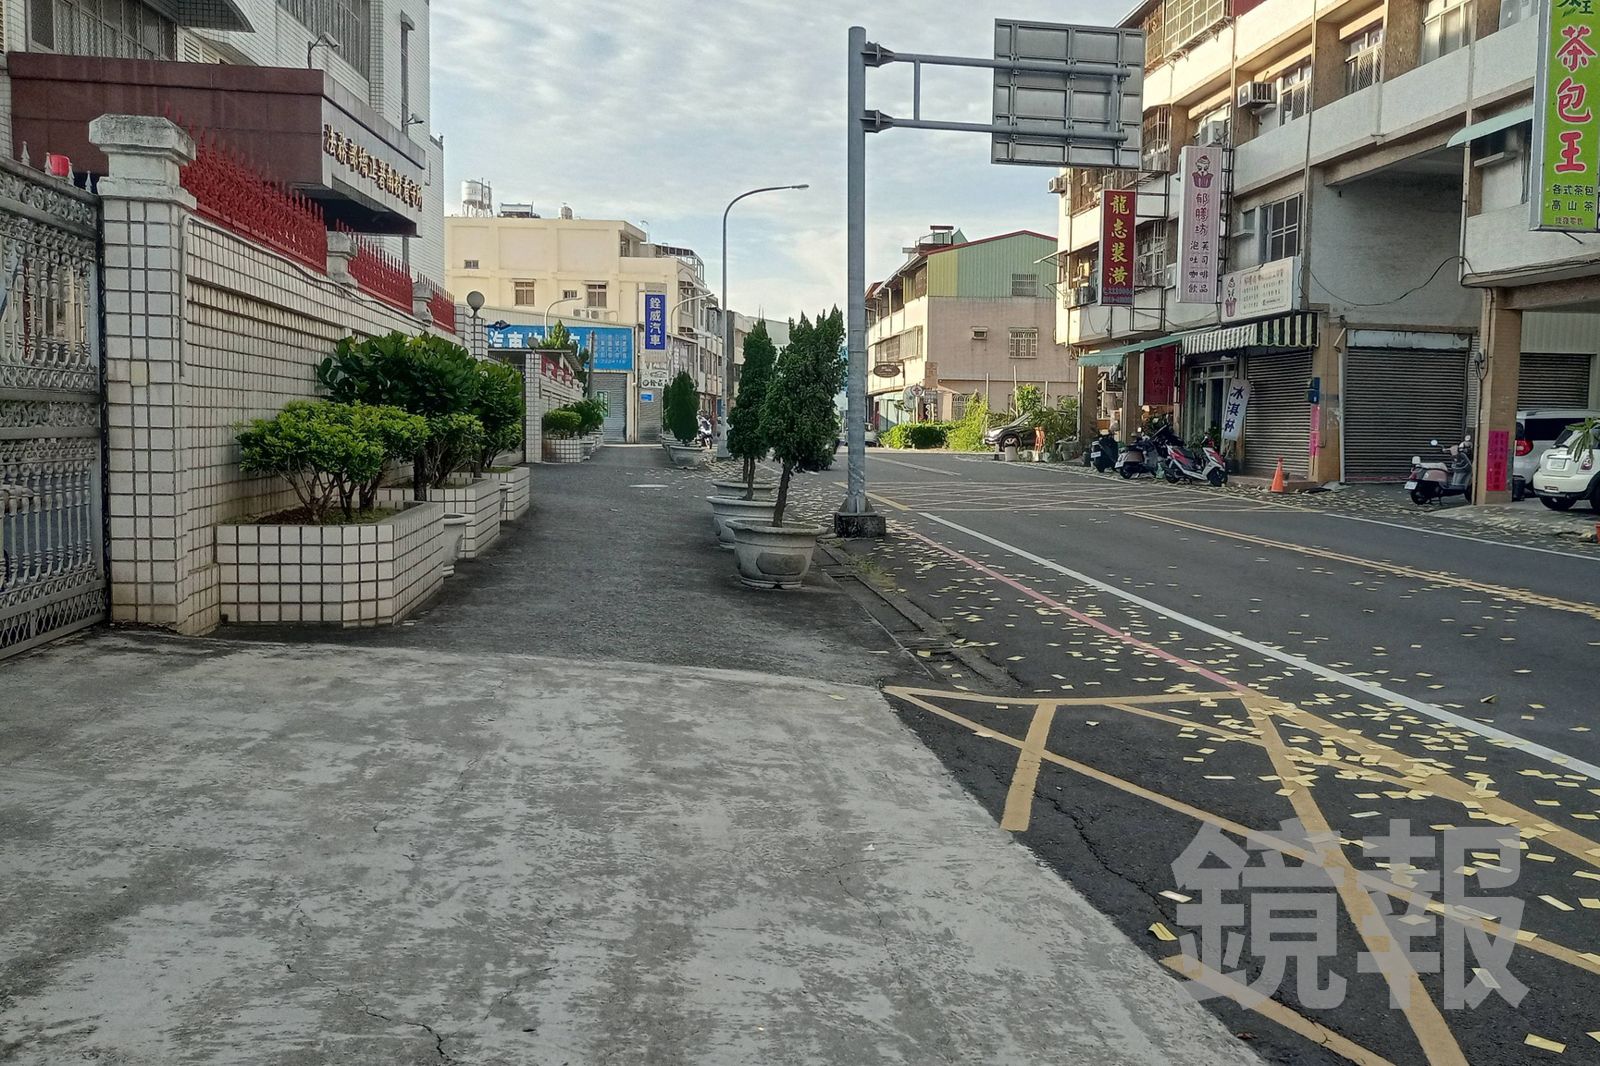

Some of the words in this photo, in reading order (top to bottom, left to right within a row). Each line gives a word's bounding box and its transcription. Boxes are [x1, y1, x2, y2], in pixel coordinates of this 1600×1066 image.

[1555, 25, 1597, 174] 茶包王
[1552, 184, 1594, 196] 各式茶包
[1551, 200, 1594, 212] 高山茶
[1190, 240, 1209, 251] 泡芙
[1189, 256, 1209, 265] 吐司
[1188, 270, 1208, 279] 咖啡
[1188, 285, 1208, 294] 飲品
[649, 297, 661, 346] 銓威汽車
